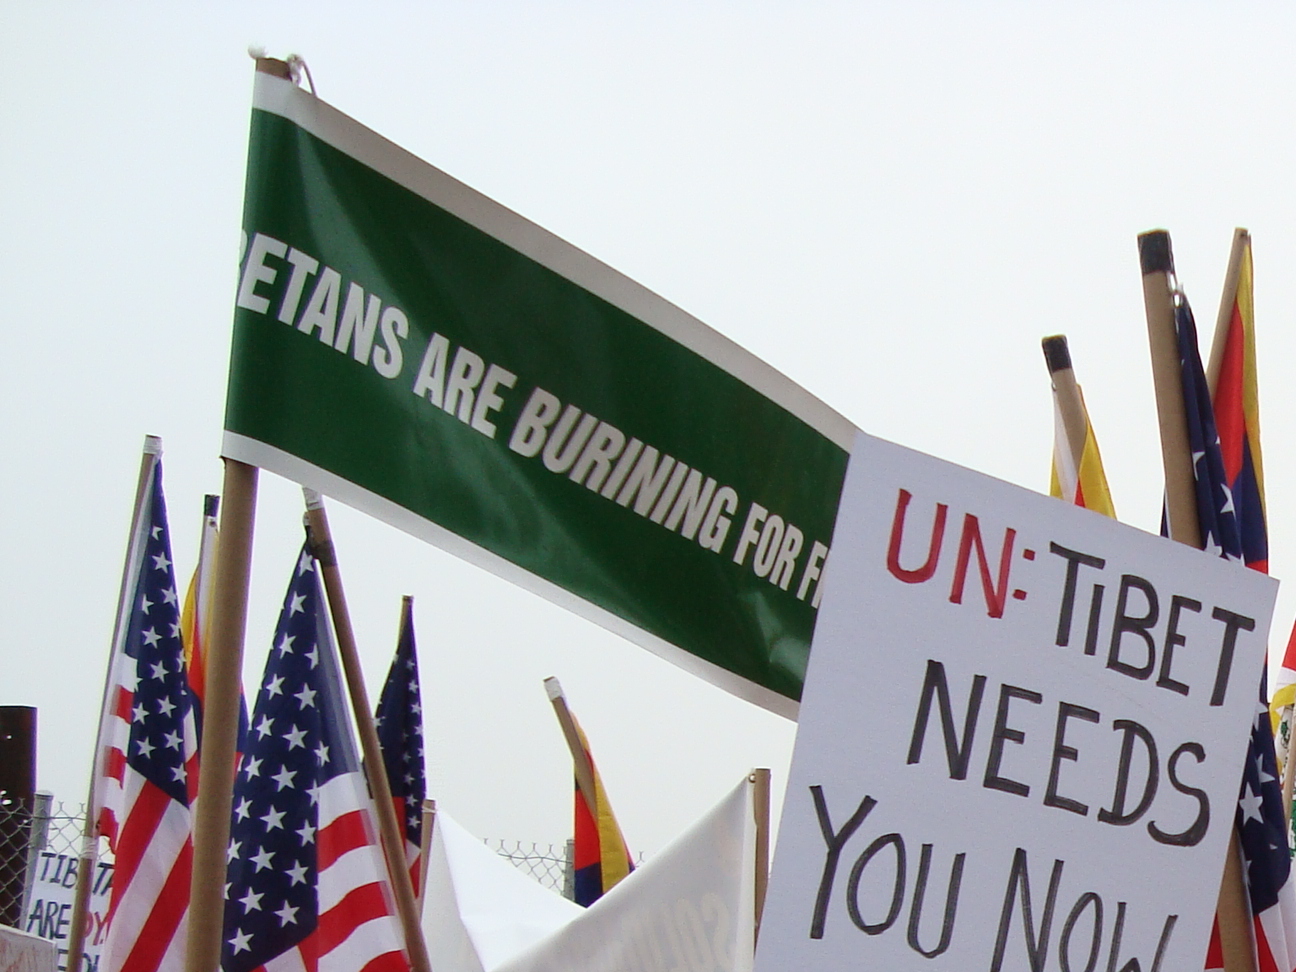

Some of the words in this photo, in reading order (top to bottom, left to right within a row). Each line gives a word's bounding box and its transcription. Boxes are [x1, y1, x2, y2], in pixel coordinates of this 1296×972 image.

[237, 229, 410, 379] ETANS
[413, 332, 518, 440] ARE
[510, 386, 739, 554] BURINING
[733, 502, 804, 591] FOR
[907, 660, 1211, 848] NEEDS
[26, 898, 72, 939] ARE
[40, 852, 115, 898] TIBT
[809, 784, 966, 960] YOU
